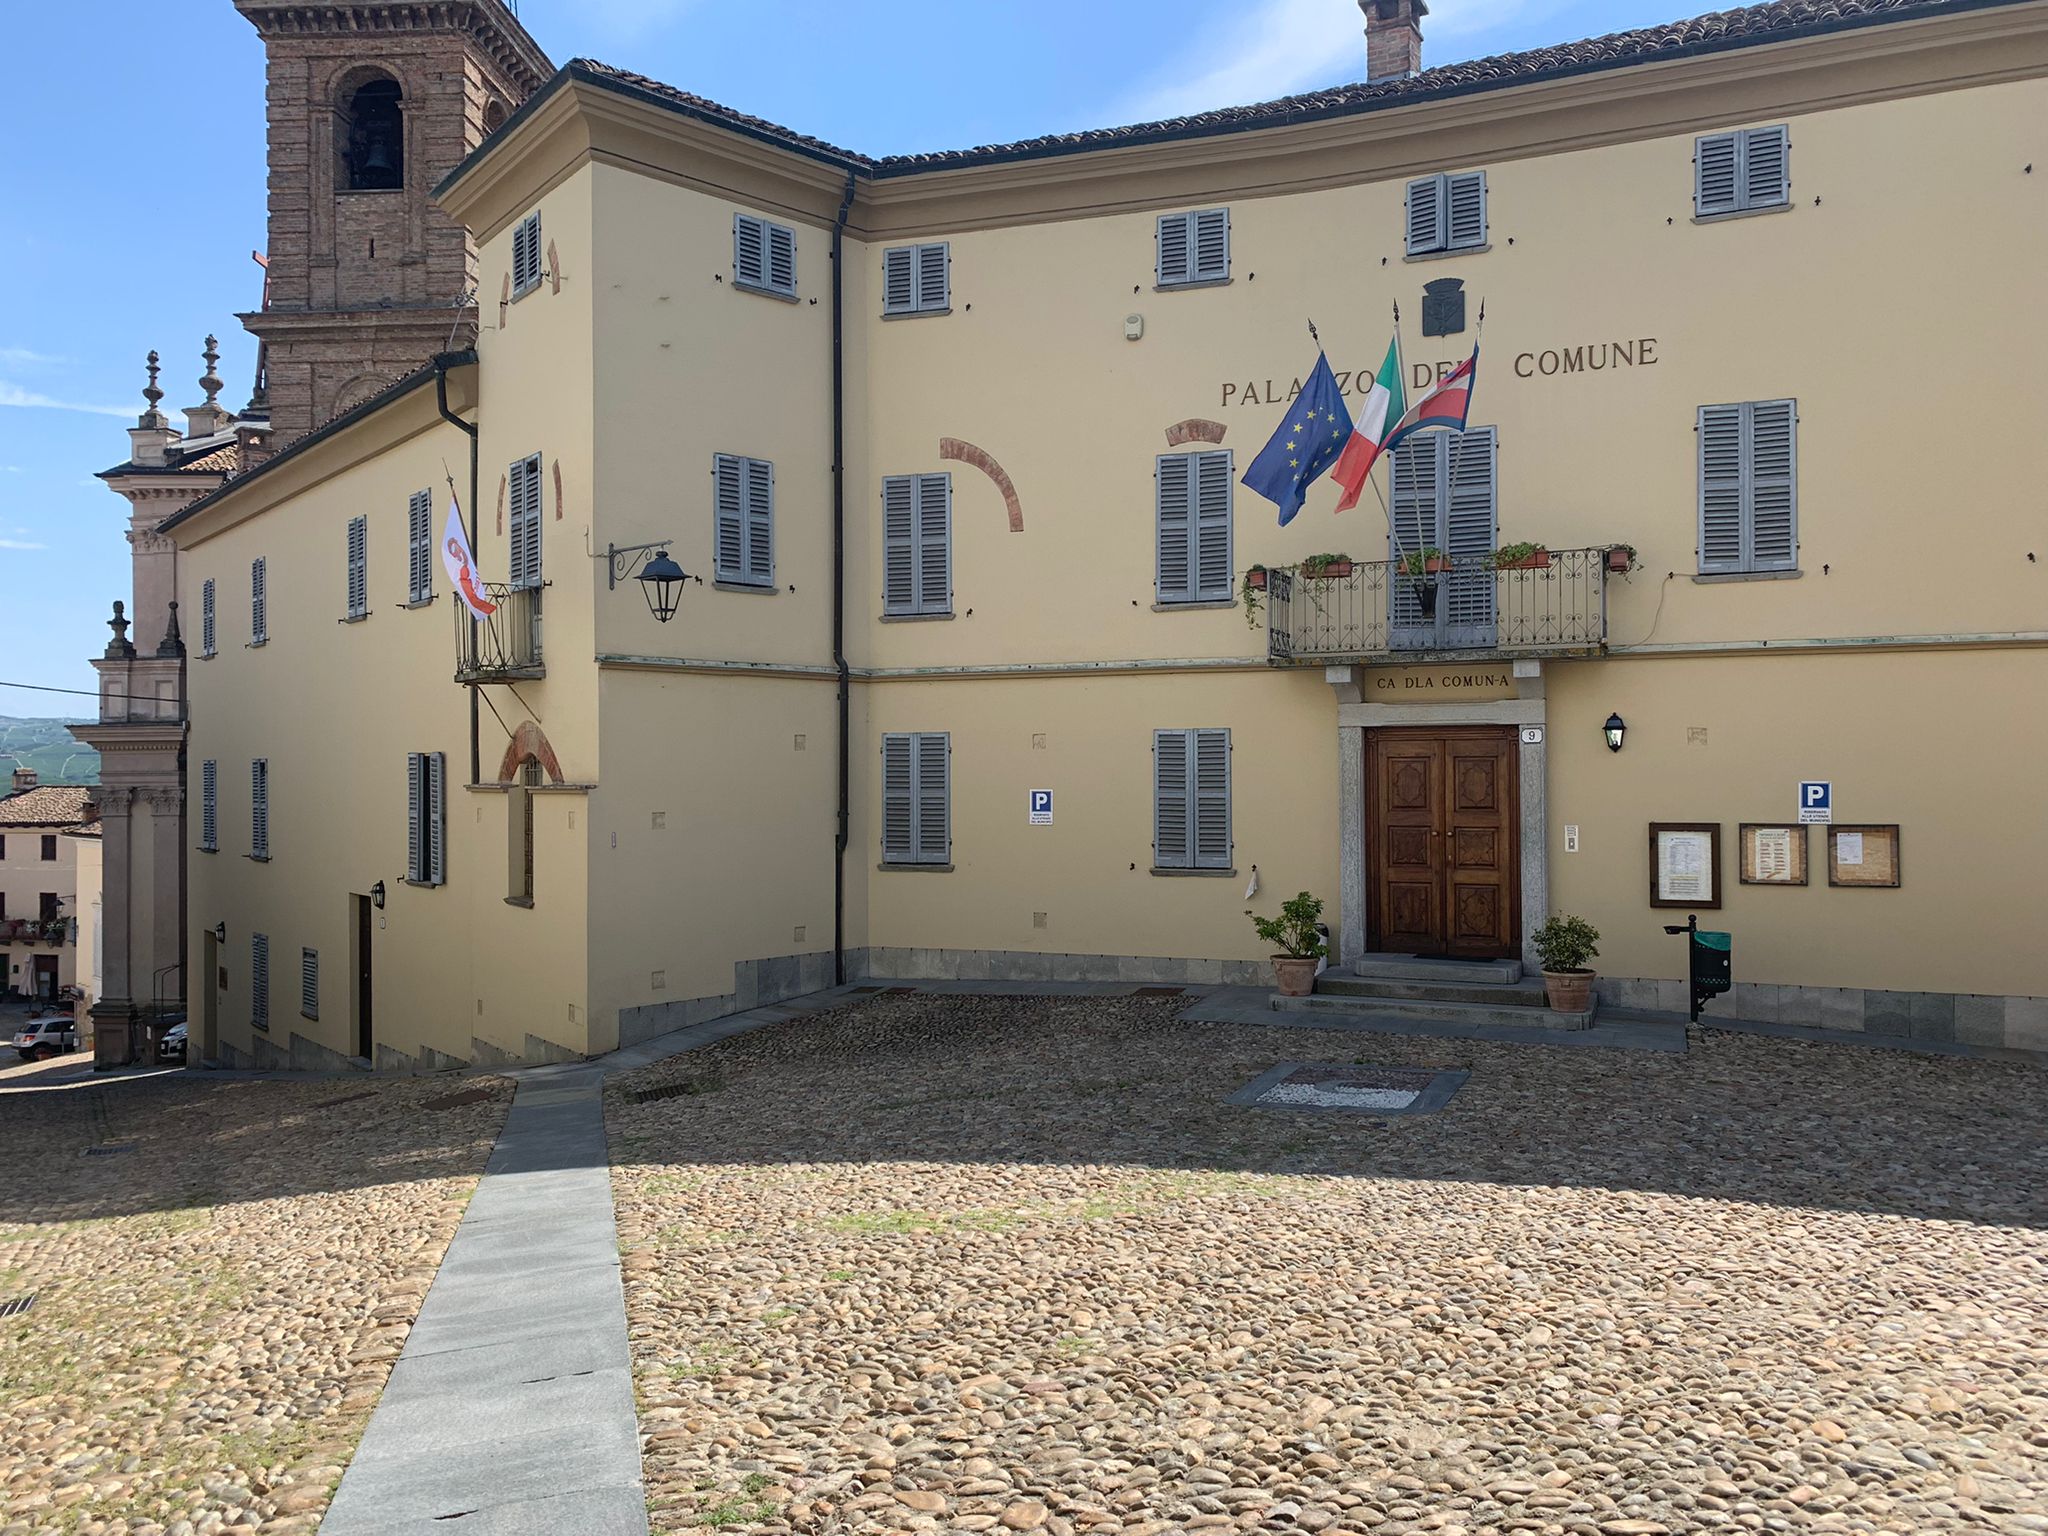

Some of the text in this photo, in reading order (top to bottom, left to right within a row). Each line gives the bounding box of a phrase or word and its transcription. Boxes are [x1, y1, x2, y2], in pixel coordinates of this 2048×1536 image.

[1221, 338, 1659, 407] PALAZO DE COMUNE
[1377, 674, 1509, 689] CA DLA COMUN-A
[1528, 731, 1536, 741] 9
[1035, 792, 1048, 810] P
[1807, 785, 1825, 806] P
